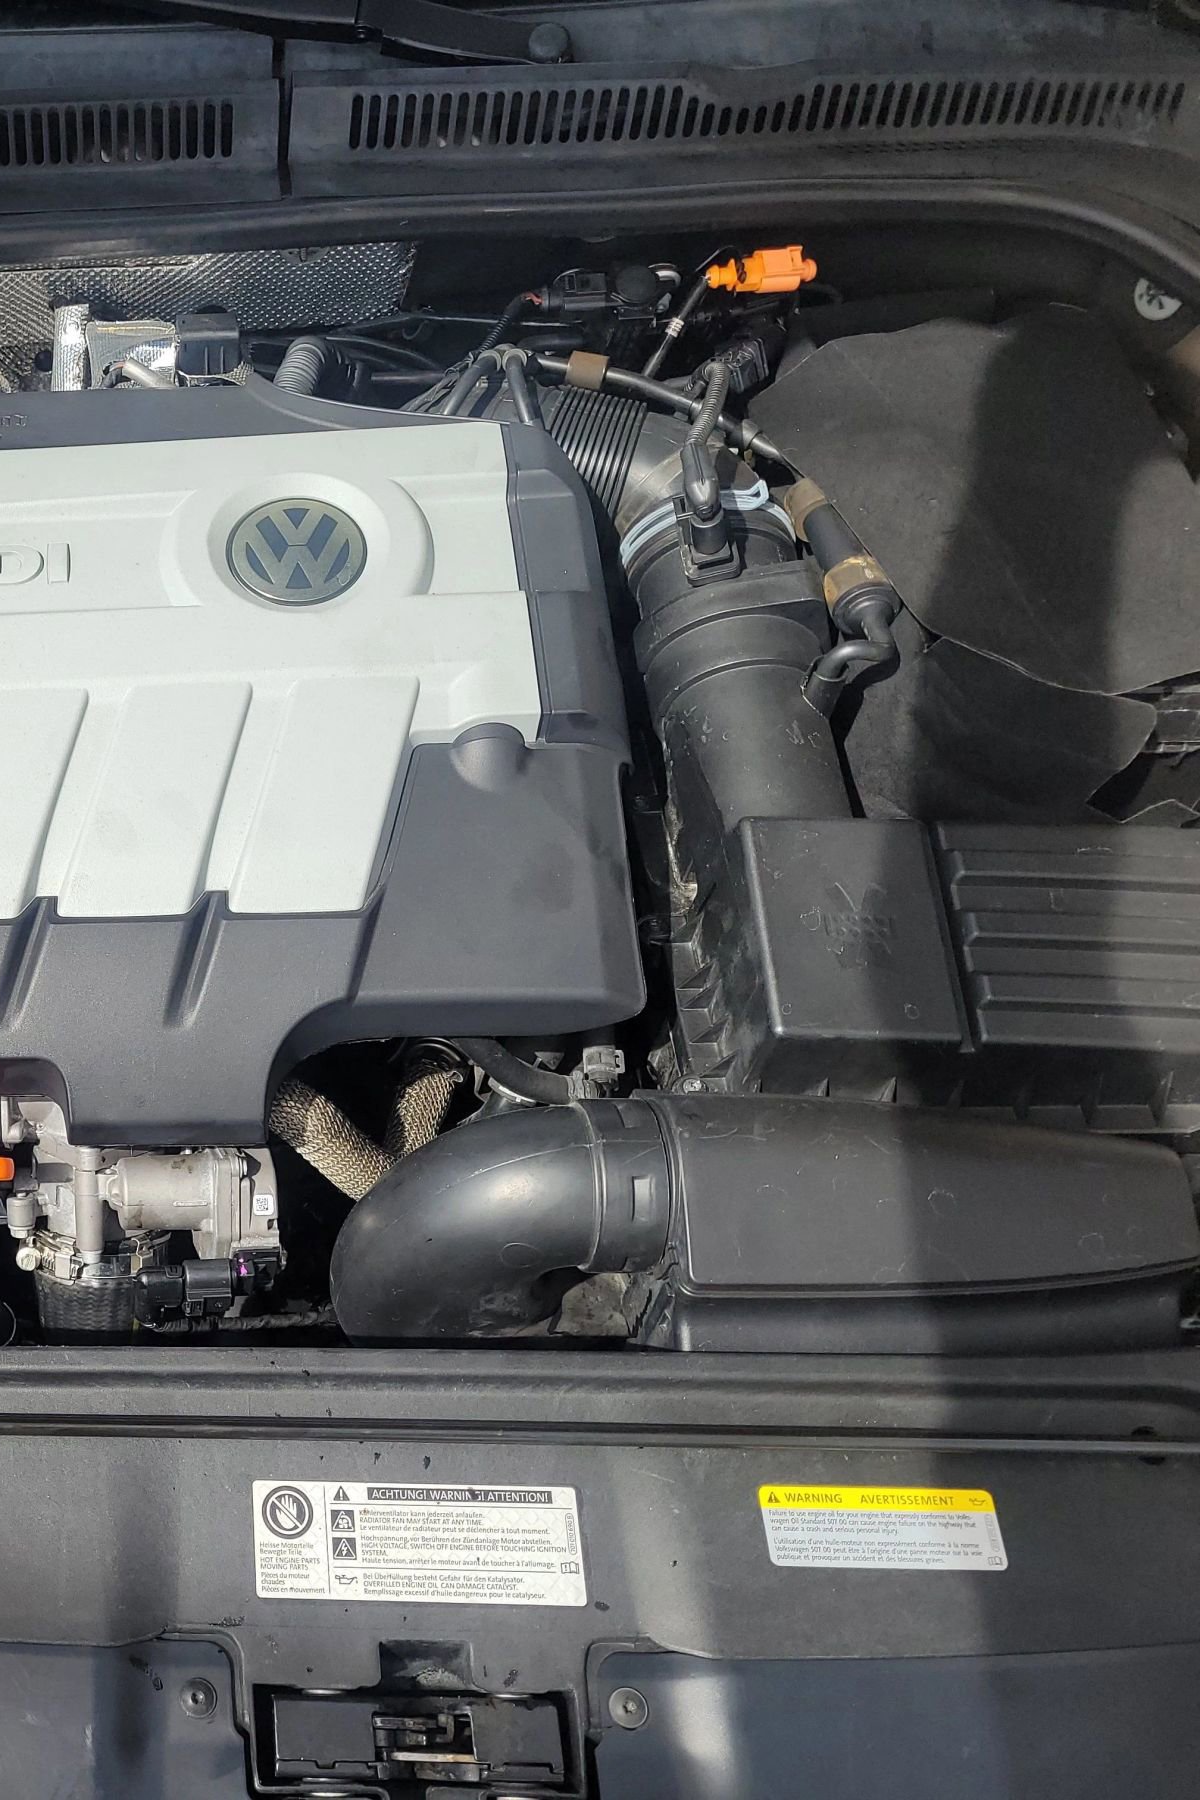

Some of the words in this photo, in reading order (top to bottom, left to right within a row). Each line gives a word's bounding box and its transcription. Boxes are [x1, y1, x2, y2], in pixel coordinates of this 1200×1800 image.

[372, 1489, 427, 1500] ACHTUNG!
[487, 1492, 548, 1503] ATTENTION!
[784, 1492, 843, 1503] WARNING
[860, 1494, 954, 1506] AVERTISSEMENT
[363, 1580, 400, 1588] OVERFILLED
